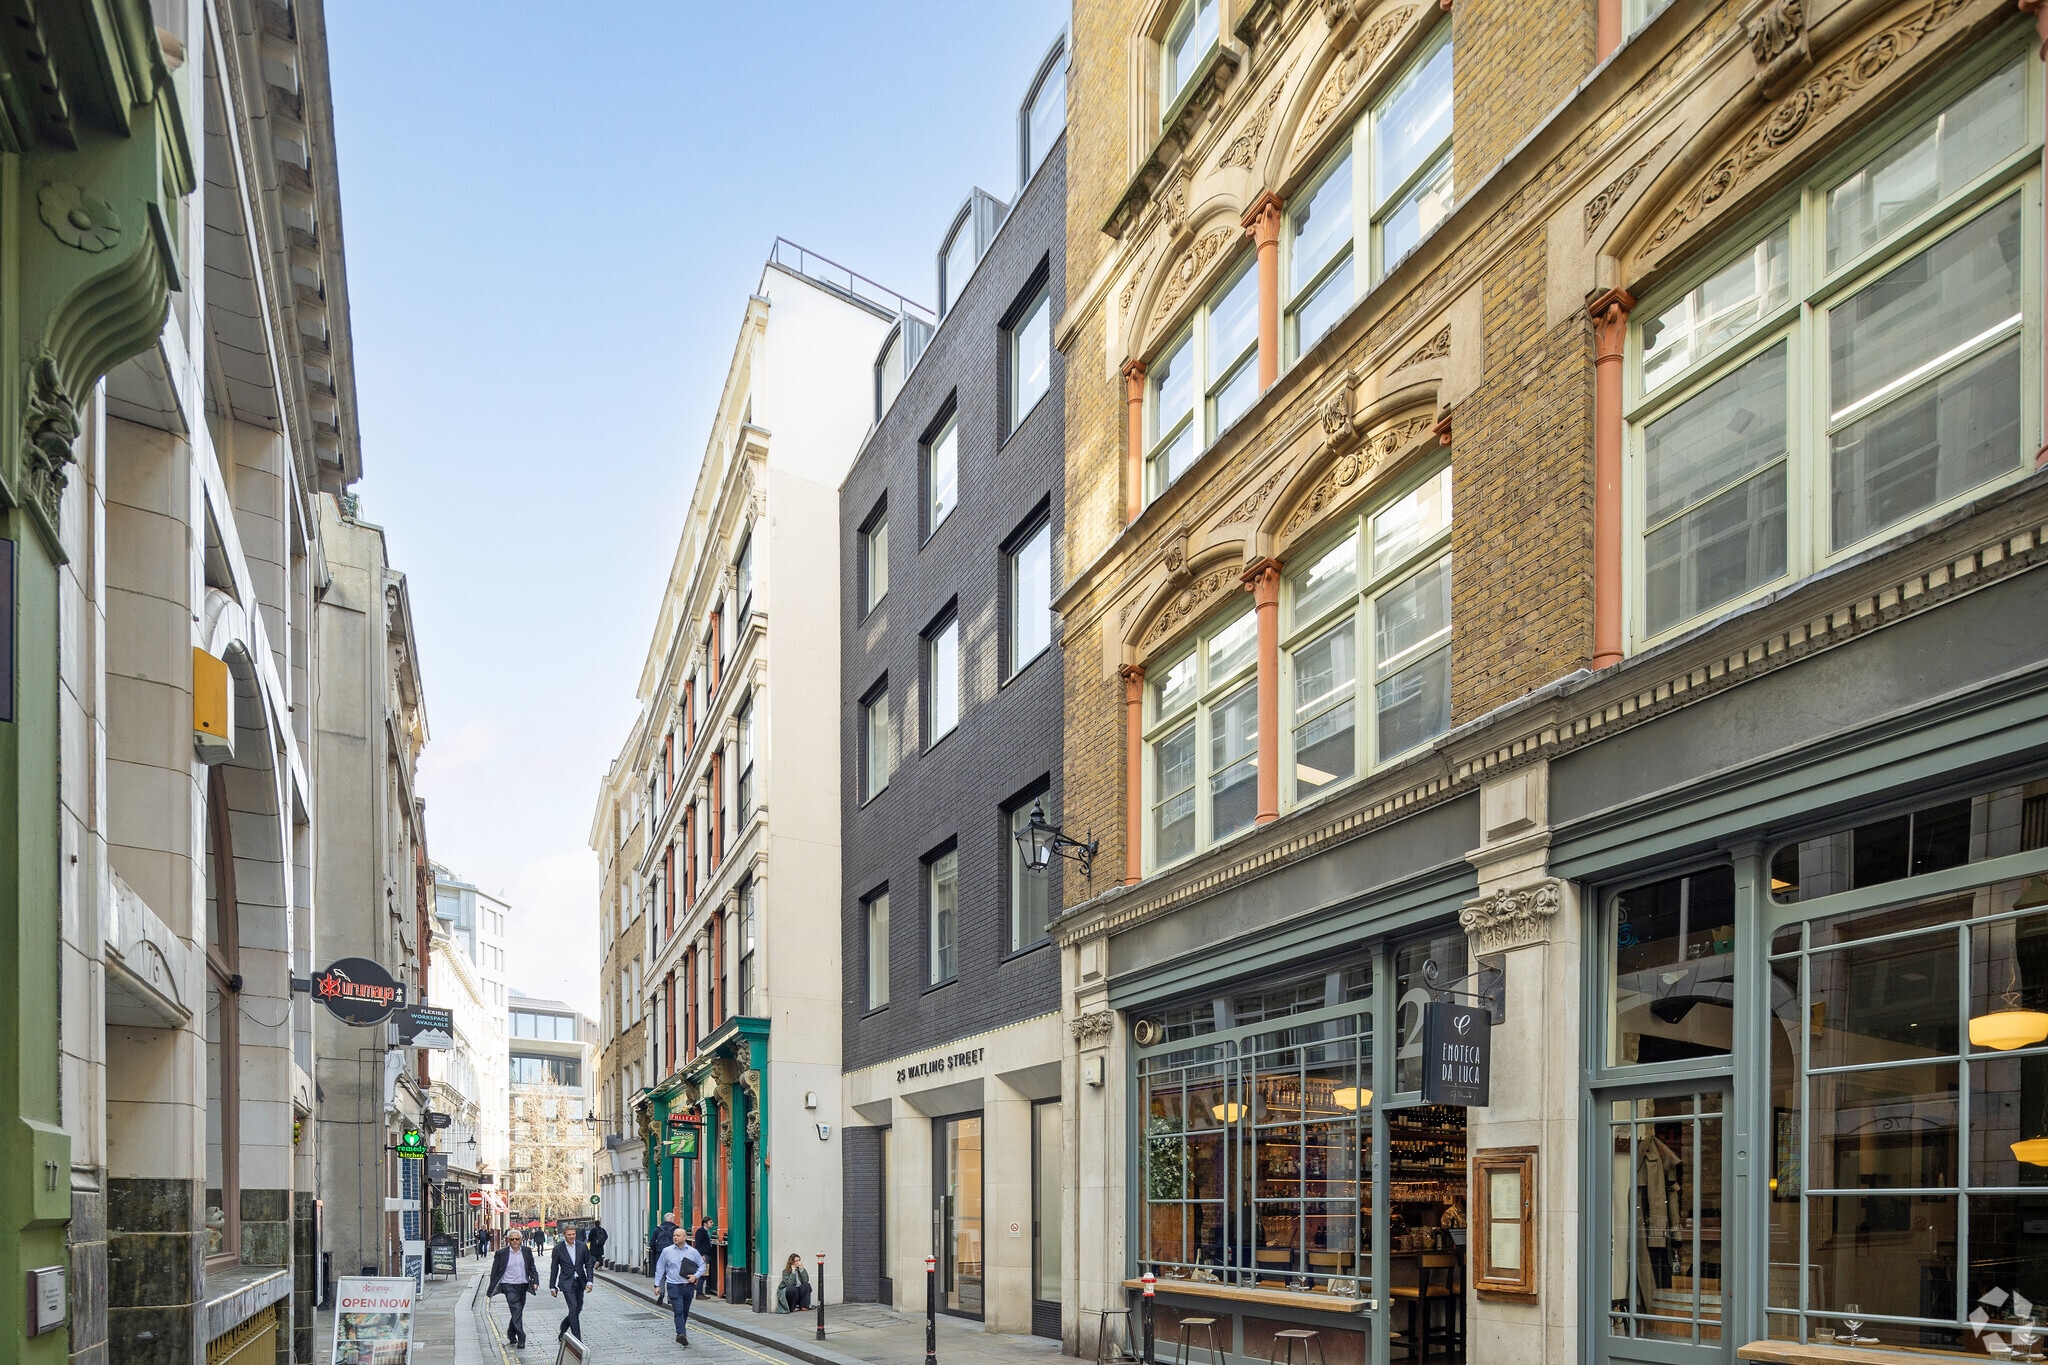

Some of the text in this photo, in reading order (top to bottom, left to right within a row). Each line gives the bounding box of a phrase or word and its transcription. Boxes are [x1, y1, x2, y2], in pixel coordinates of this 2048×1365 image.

[420, 1008, 449, 1016] FLEXIBLE
[410, 1013, 449, 1022] WORKSPACE
[415, 1019, 449, 1028] AVAILABLE
[1442, 1042, 1480, 1065] ENOTECA
[896, 1047, 985, 1083] 25 WATLING STREET
[1442, 1063, 1480, 1084] DA LUCA
[397, 1145, 427, 1153] remedy
[342, 1298, 411, 1308] OPEN NOW
